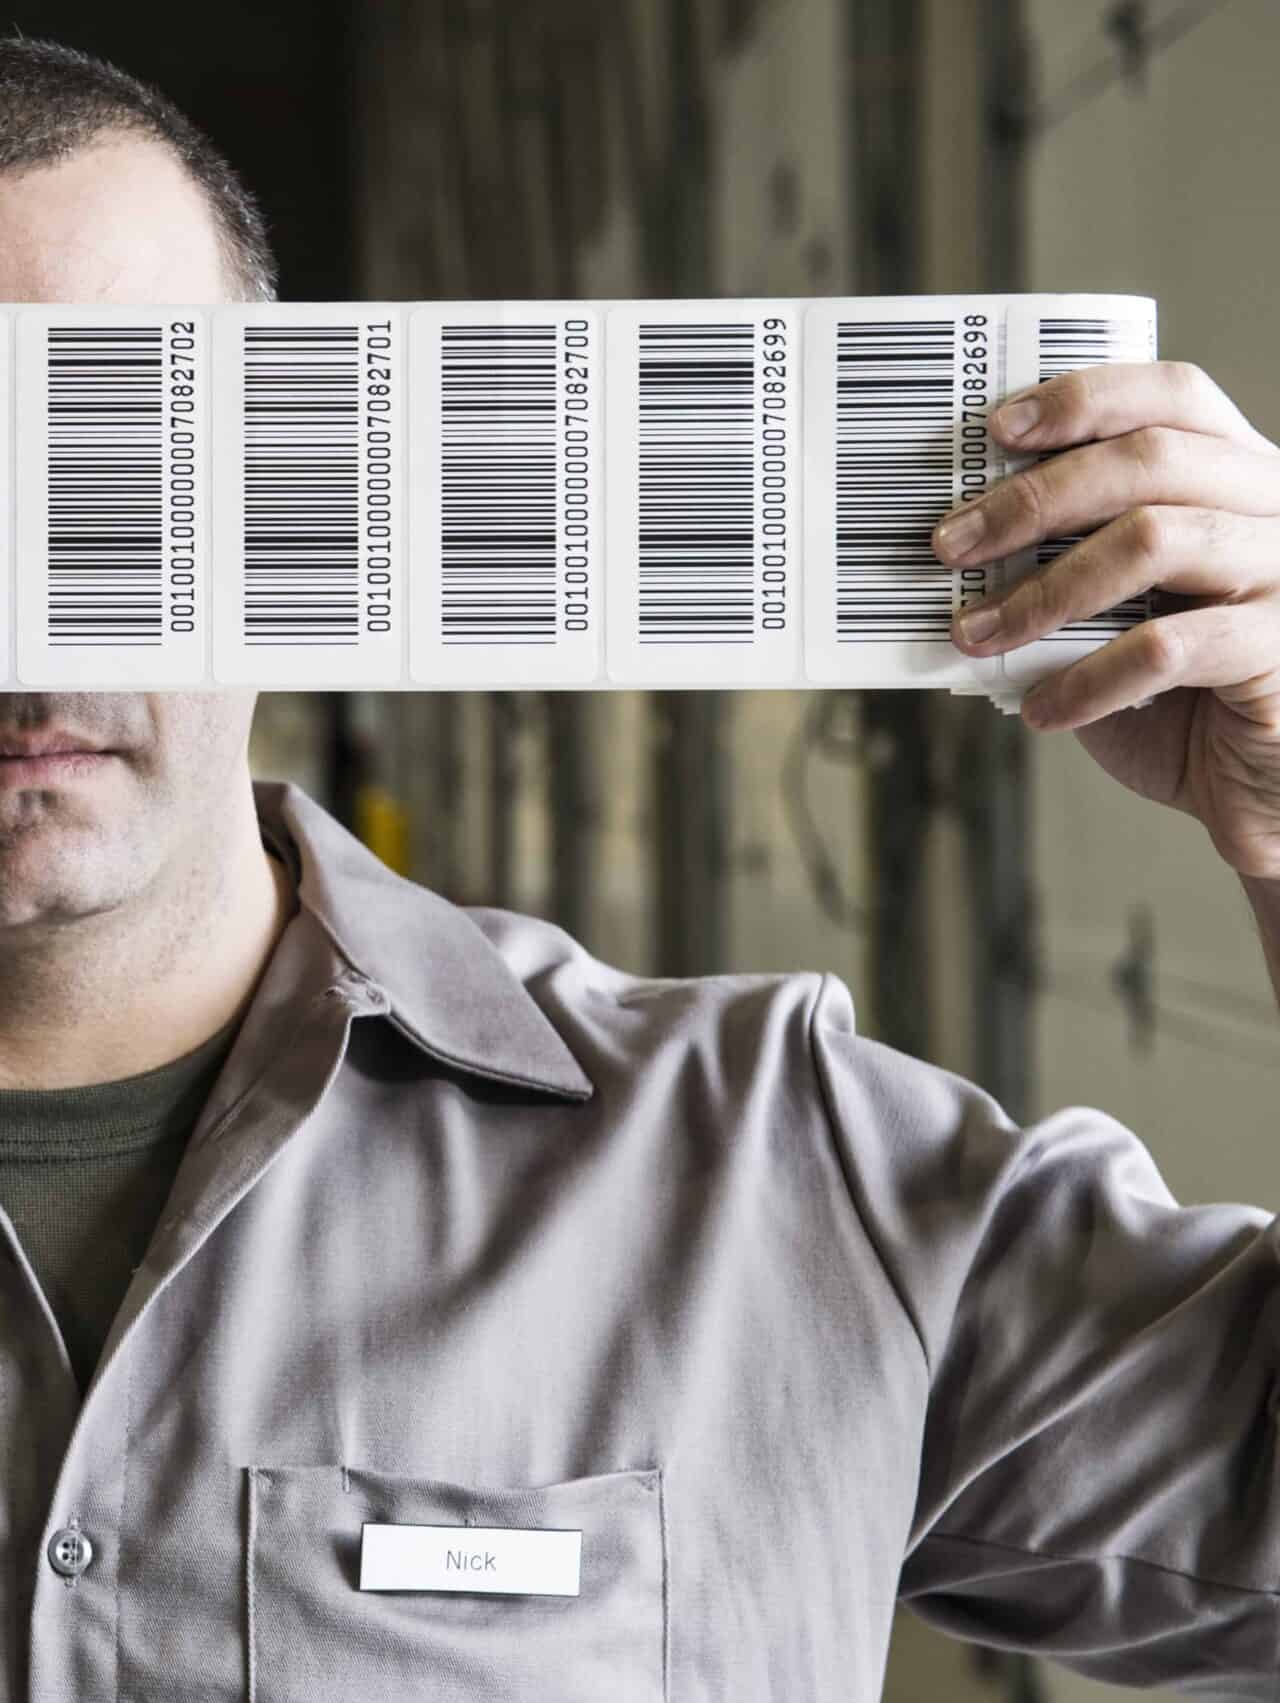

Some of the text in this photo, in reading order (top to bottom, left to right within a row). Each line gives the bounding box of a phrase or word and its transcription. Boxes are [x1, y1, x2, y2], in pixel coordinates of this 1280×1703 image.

[171, 322, 195, 632] 00100100000007082702
[368, 321, 391, 632] 00100100000007082701
[565, 320, 589, 631] 00100100000007082700
[762, 318, 786, 630] 00100100000007082699
[446, 1550, 496, 1571] Nick
